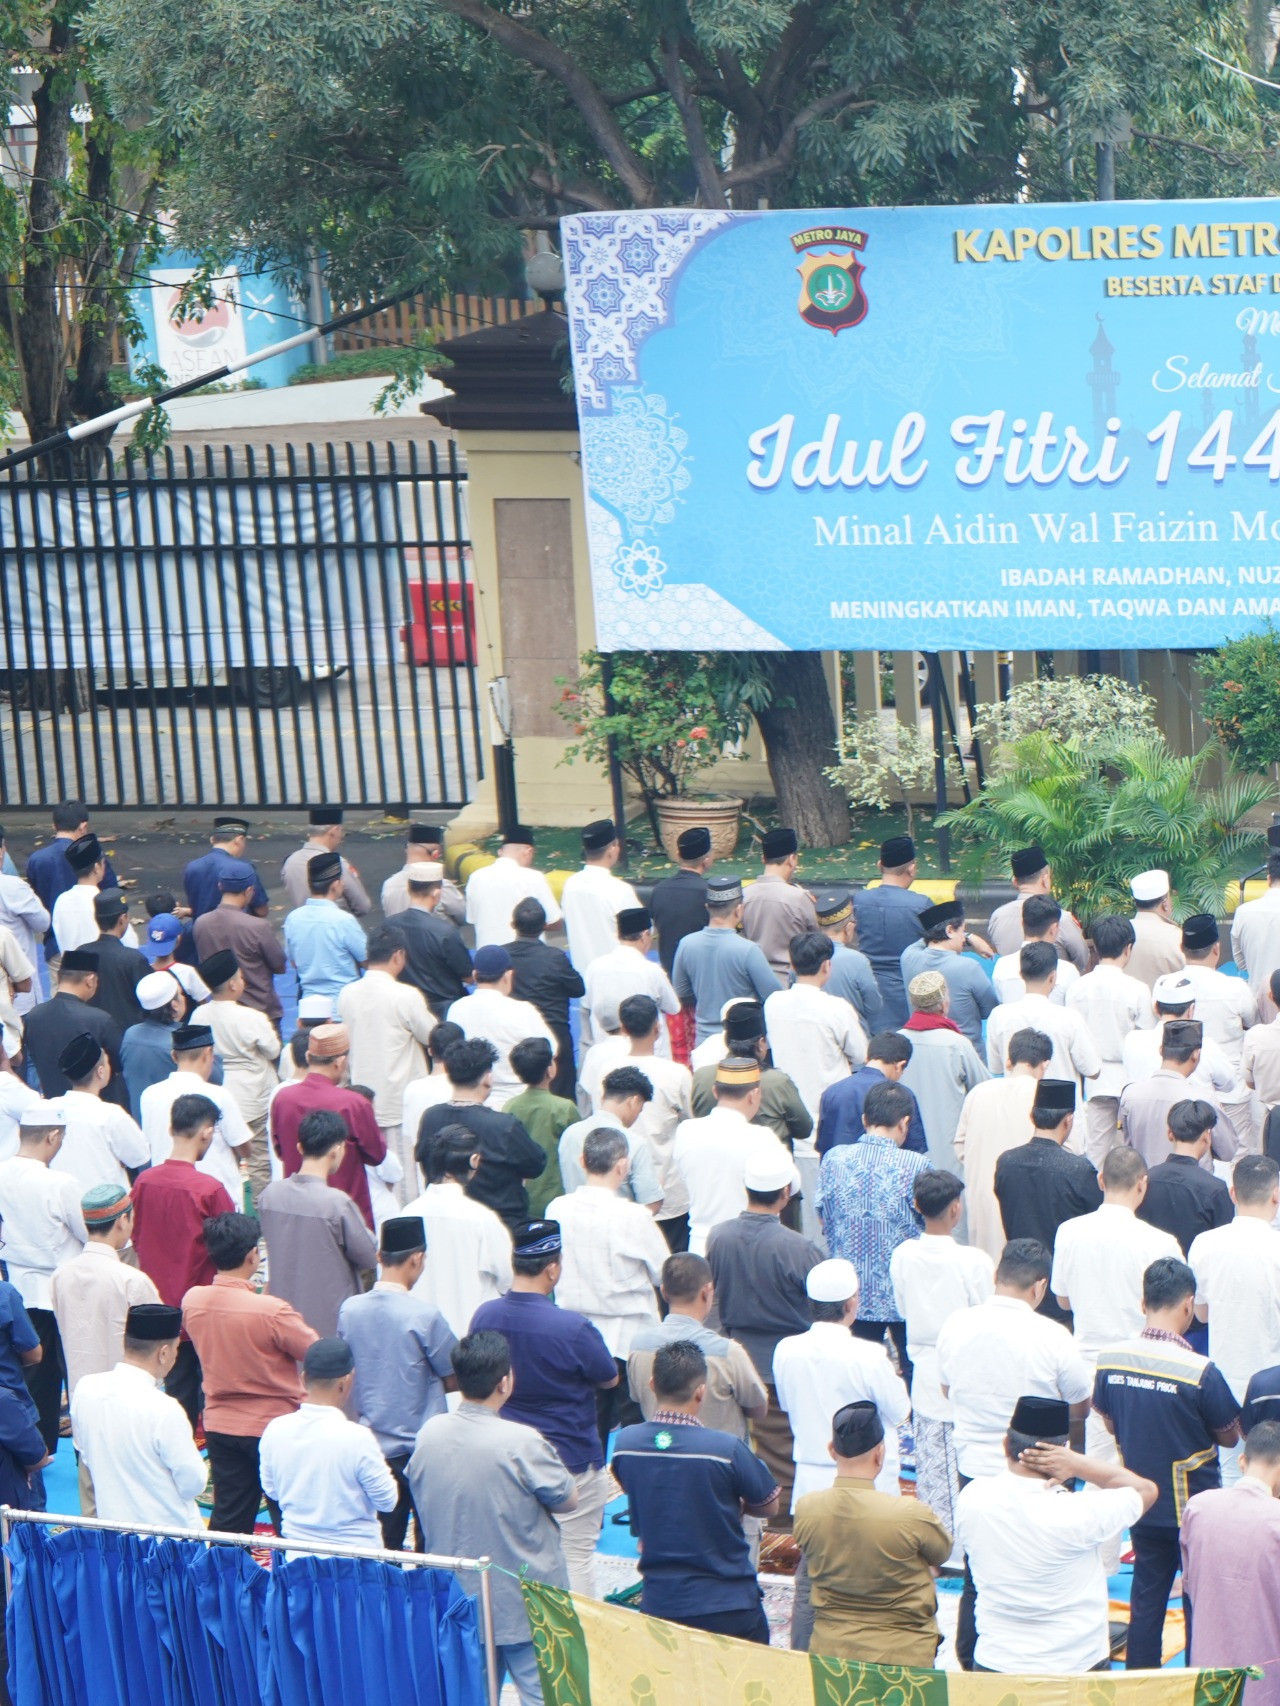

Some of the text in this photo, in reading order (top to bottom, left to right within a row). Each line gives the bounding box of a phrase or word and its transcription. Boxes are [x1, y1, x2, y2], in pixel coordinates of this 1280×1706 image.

[792, 229, 862, 247] METRO JAYA
[955, 224, 1164, 263] KAPOLRES
[1106, 275, 1205, 297] BESERTA
[1211, 273, 1268, 295] STAF
[170, 349, 237, 371] ASEAN
[1152, 354, 1262, 393] Selamat
[746, 411, 929, 490] Idul
[950, 409, 1130, 487] Fitri
[812, 514, 914, 546] Minal
[924, 513, 1020, 545] Aidin
[1028, 512, 1100, 544] Wal
[1110, 510, 1219, 543] Faizin
[1001, 568, 1086, 587] IBADAH
[1092, 566, 1232, 588] RAMADHAN,
[830, 600, 1009, 619] MENINGKATKAN
[1016, 599, 1082, 620] IMAN,
[1087, 598, 1171, 620] TAQWA
[1177, 598, 1226, 616] DAN
[1126, 1376, 1155, 1389] TANJUNG
[1156, 1382, 1178, 1394] PRIOK
